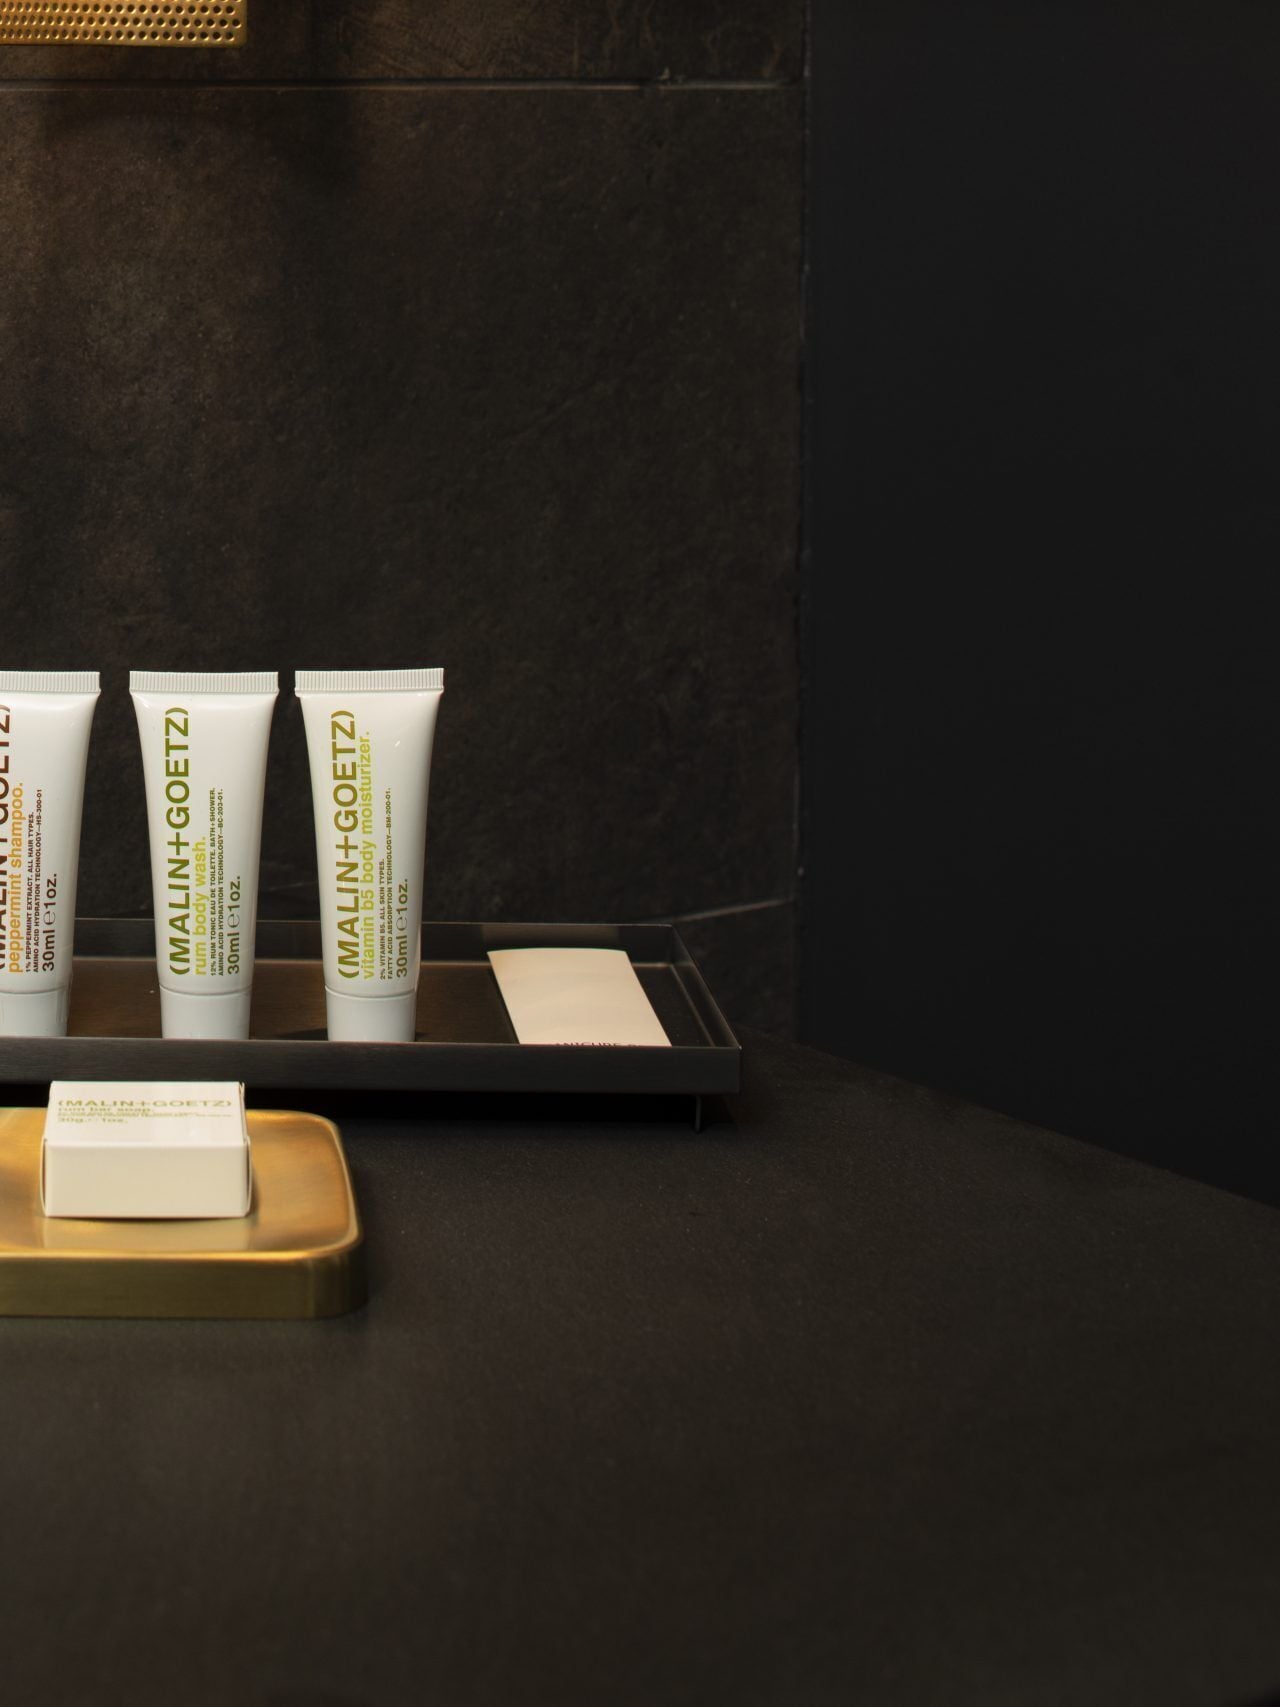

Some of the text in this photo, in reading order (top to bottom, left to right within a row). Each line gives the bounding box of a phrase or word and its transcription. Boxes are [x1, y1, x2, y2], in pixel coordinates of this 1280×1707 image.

[165, 707, 190, 975] (MALIN+GOETZ)
[331, 711, 360, 979] (MALIN+GOETZ)
[357, 731, 376, 979] vitamin b5 body moisturizer.
[8, 783, 26, 973] peppermint shampoo.
[210, 888, 216, 898] DE
[192, 837, 210, 976] rum body wash.
[26, 962, 32, 972] 1%
[42, 929, 55, 972] 30ml
[227, 932, 240, 975] 30ml
[396, 935, 408, 978] 30ml
[380, 968, 386, 980] 2%
